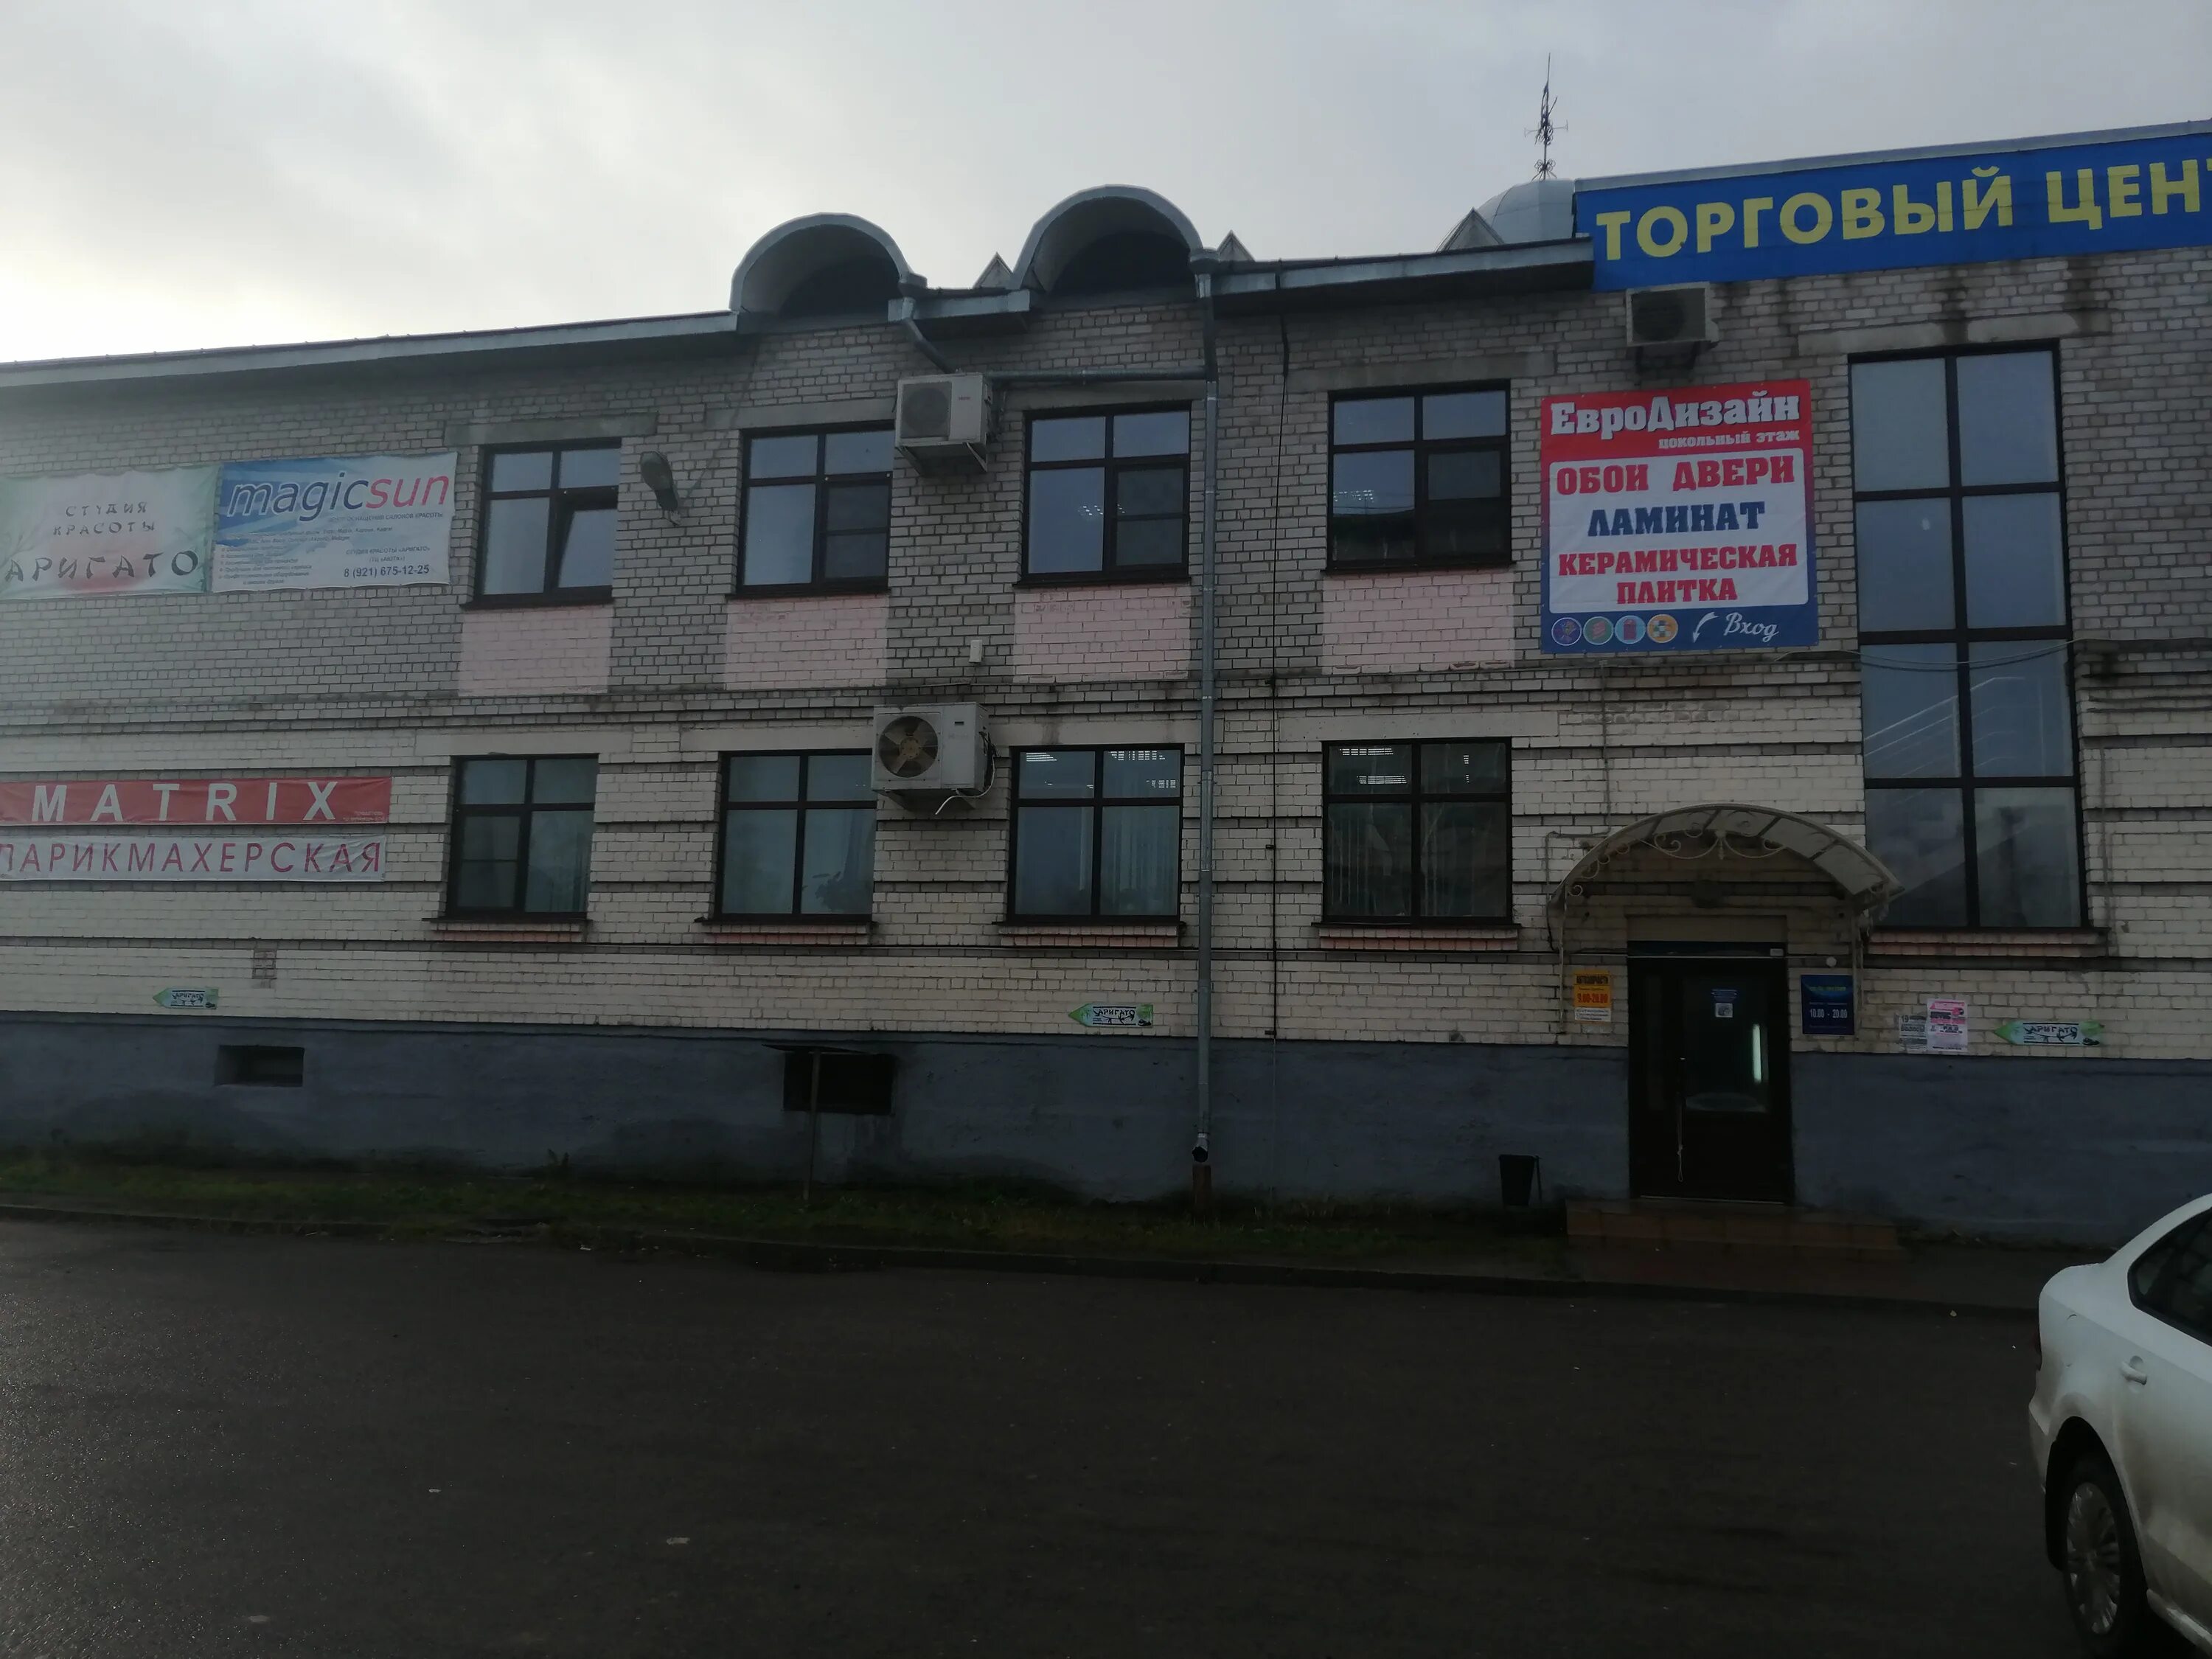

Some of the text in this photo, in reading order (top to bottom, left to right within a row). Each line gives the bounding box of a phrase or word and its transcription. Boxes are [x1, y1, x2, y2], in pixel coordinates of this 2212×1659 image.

[1596, 166, 2014, 260] ТОРГОВЫЙ
[1551, 389, 1801, 440] ЕвроДизайн
[1658, 430, 1800, 449] цокольный этаж
[1556, 455, 1795, 495] ОБОИ ДВЕРИ
[66, 501, 148, 518] СТУДИЯ
[228, 472, 450, 521] magicsun
[52, 520, 156, 536] КРАСОТЫ
[1587, 501, 1766, 538] ЛАМИНАТ
[4, 549, 199, 582] АРИГАТО
[344, 564, 430, 579] 8 (921) 675-12-25
[1557, 543, 1798, 577] КЕРАМИЧЕСКАЯ
[1616, 577, 1738, 605] ПЛИТКА
[1722, 611, 1780, 643] Вход
[32, 782, 338, 822] MATRIX
[0, 842, 380, 873] ПАРИКМАХЕРСКАЯ
